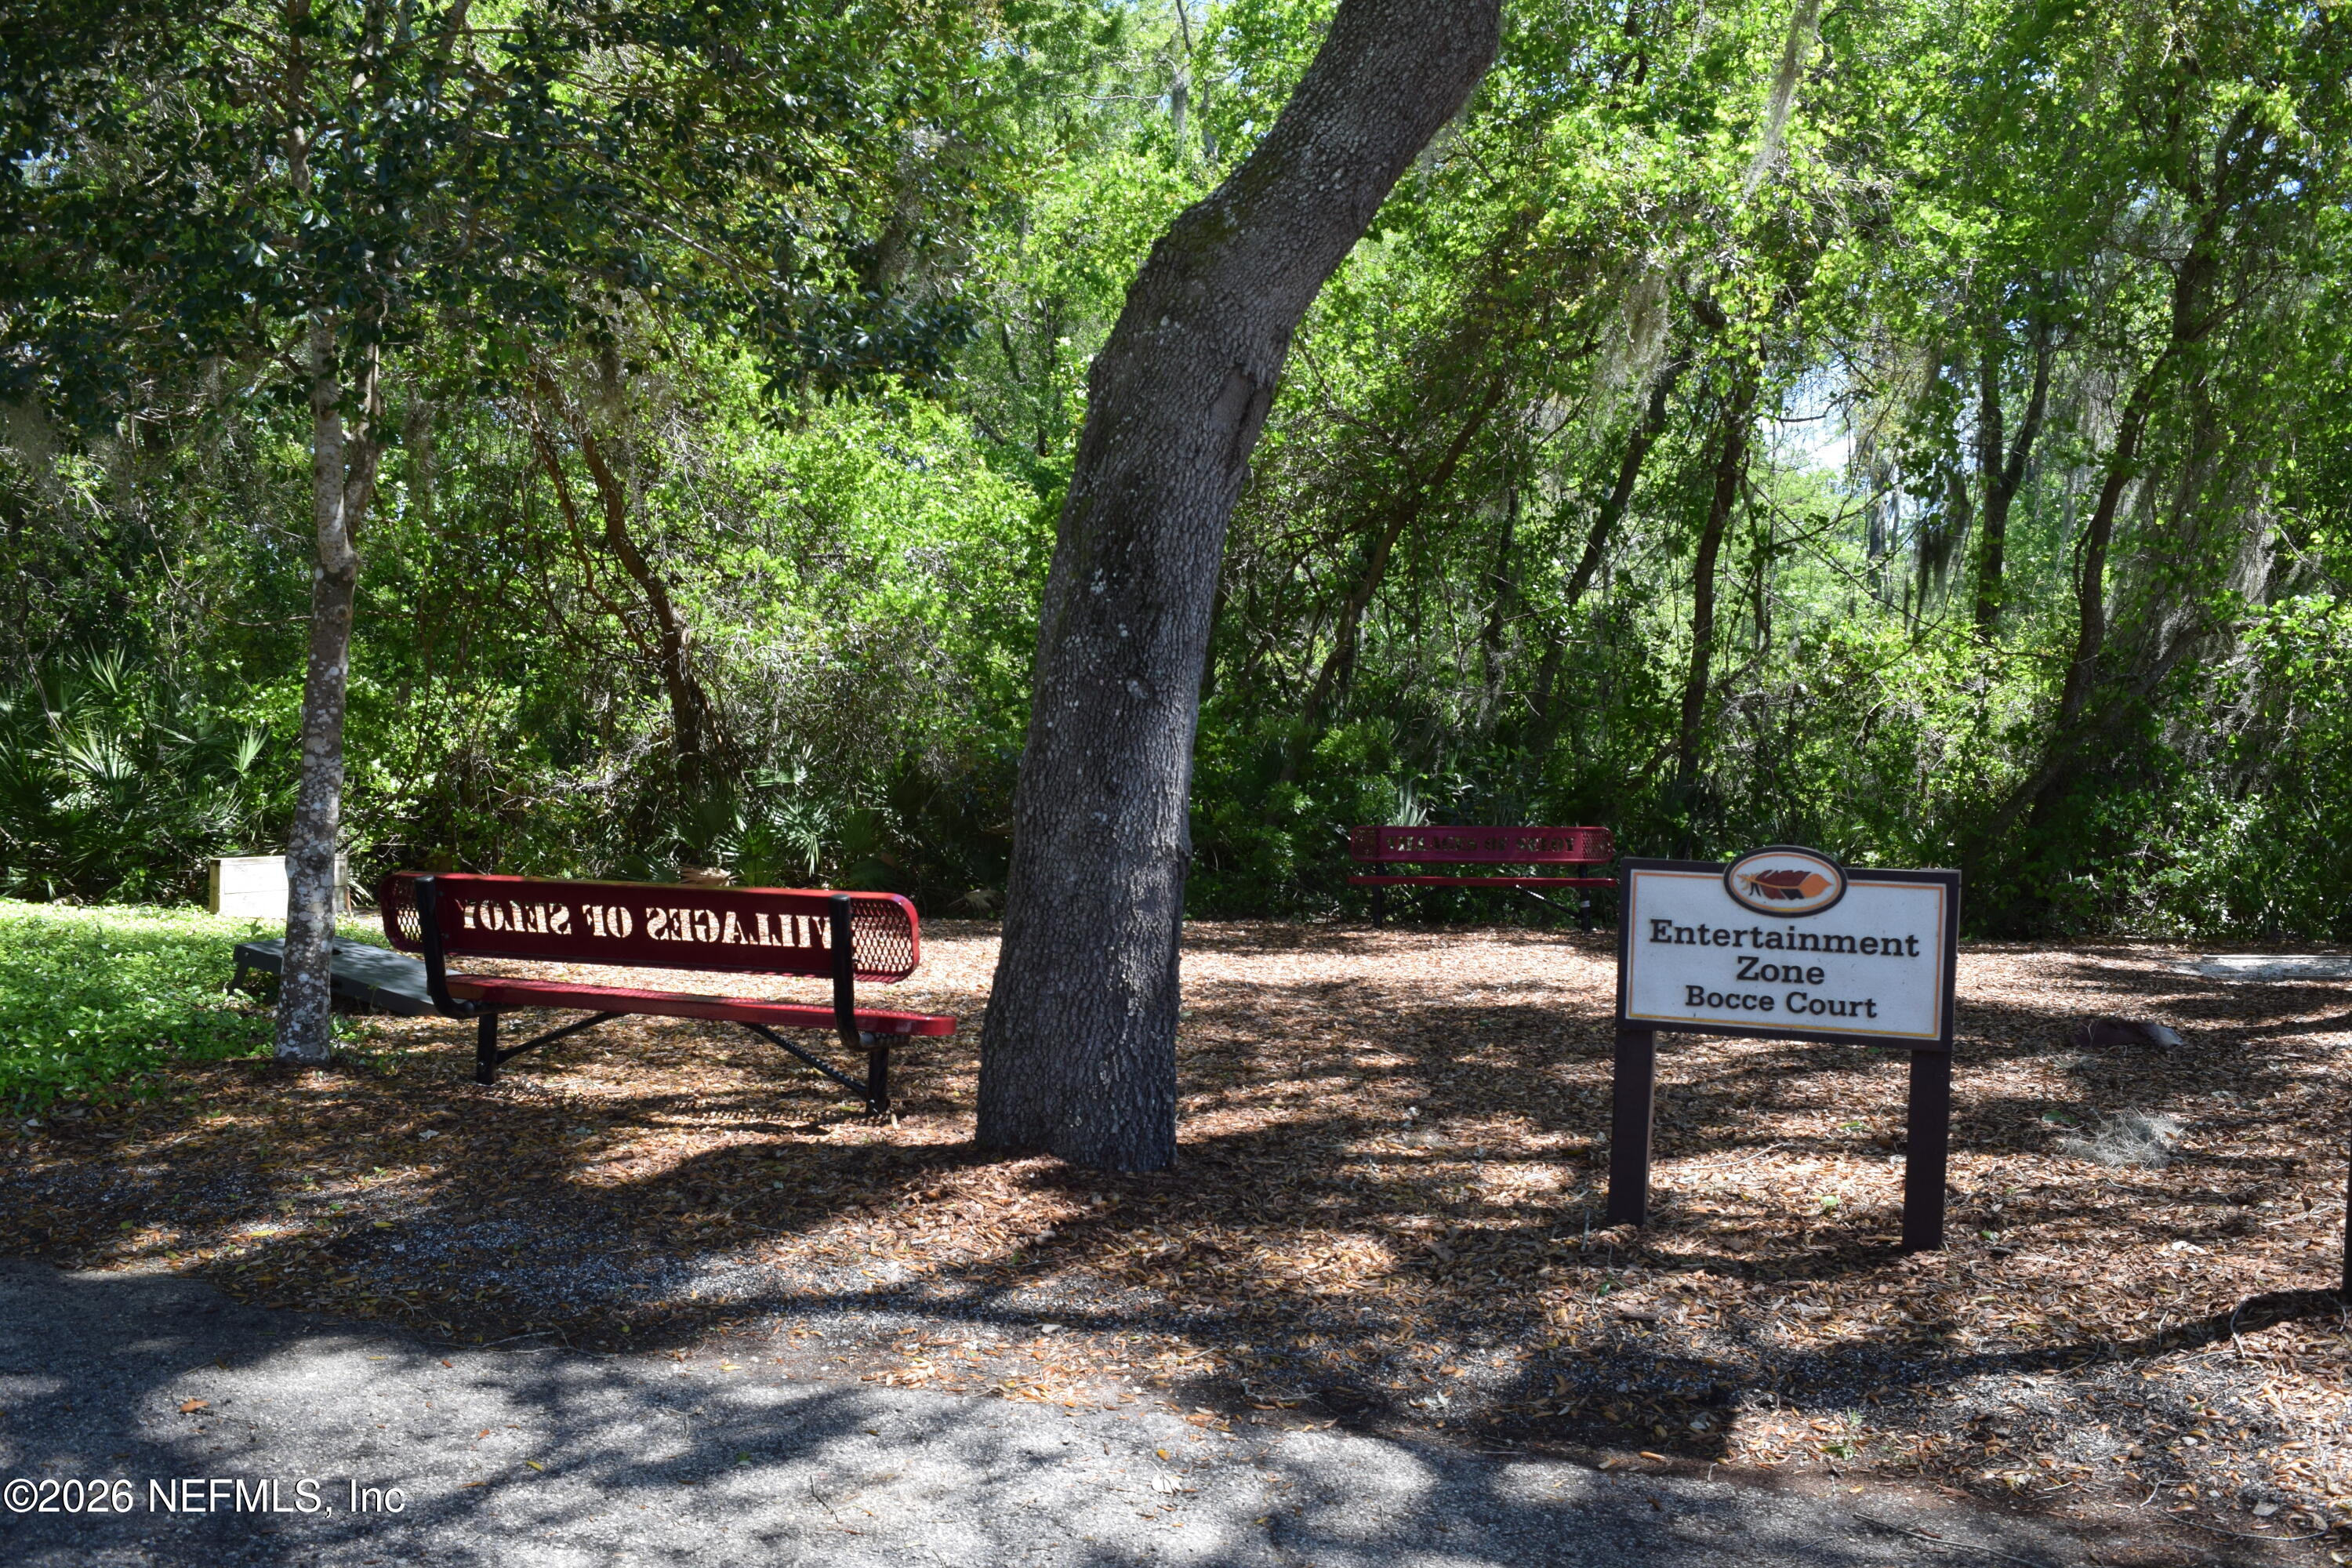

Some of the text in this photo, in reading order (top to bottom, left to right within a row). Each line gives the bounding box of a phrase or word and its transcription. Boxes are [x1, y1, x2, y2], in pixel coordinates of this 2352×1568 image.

[1650, 918, 1920, 957] Entertainment
[1736, 955, 1826, 985] Zone
[1685, 985, 1878, 1018] Bocce Court
